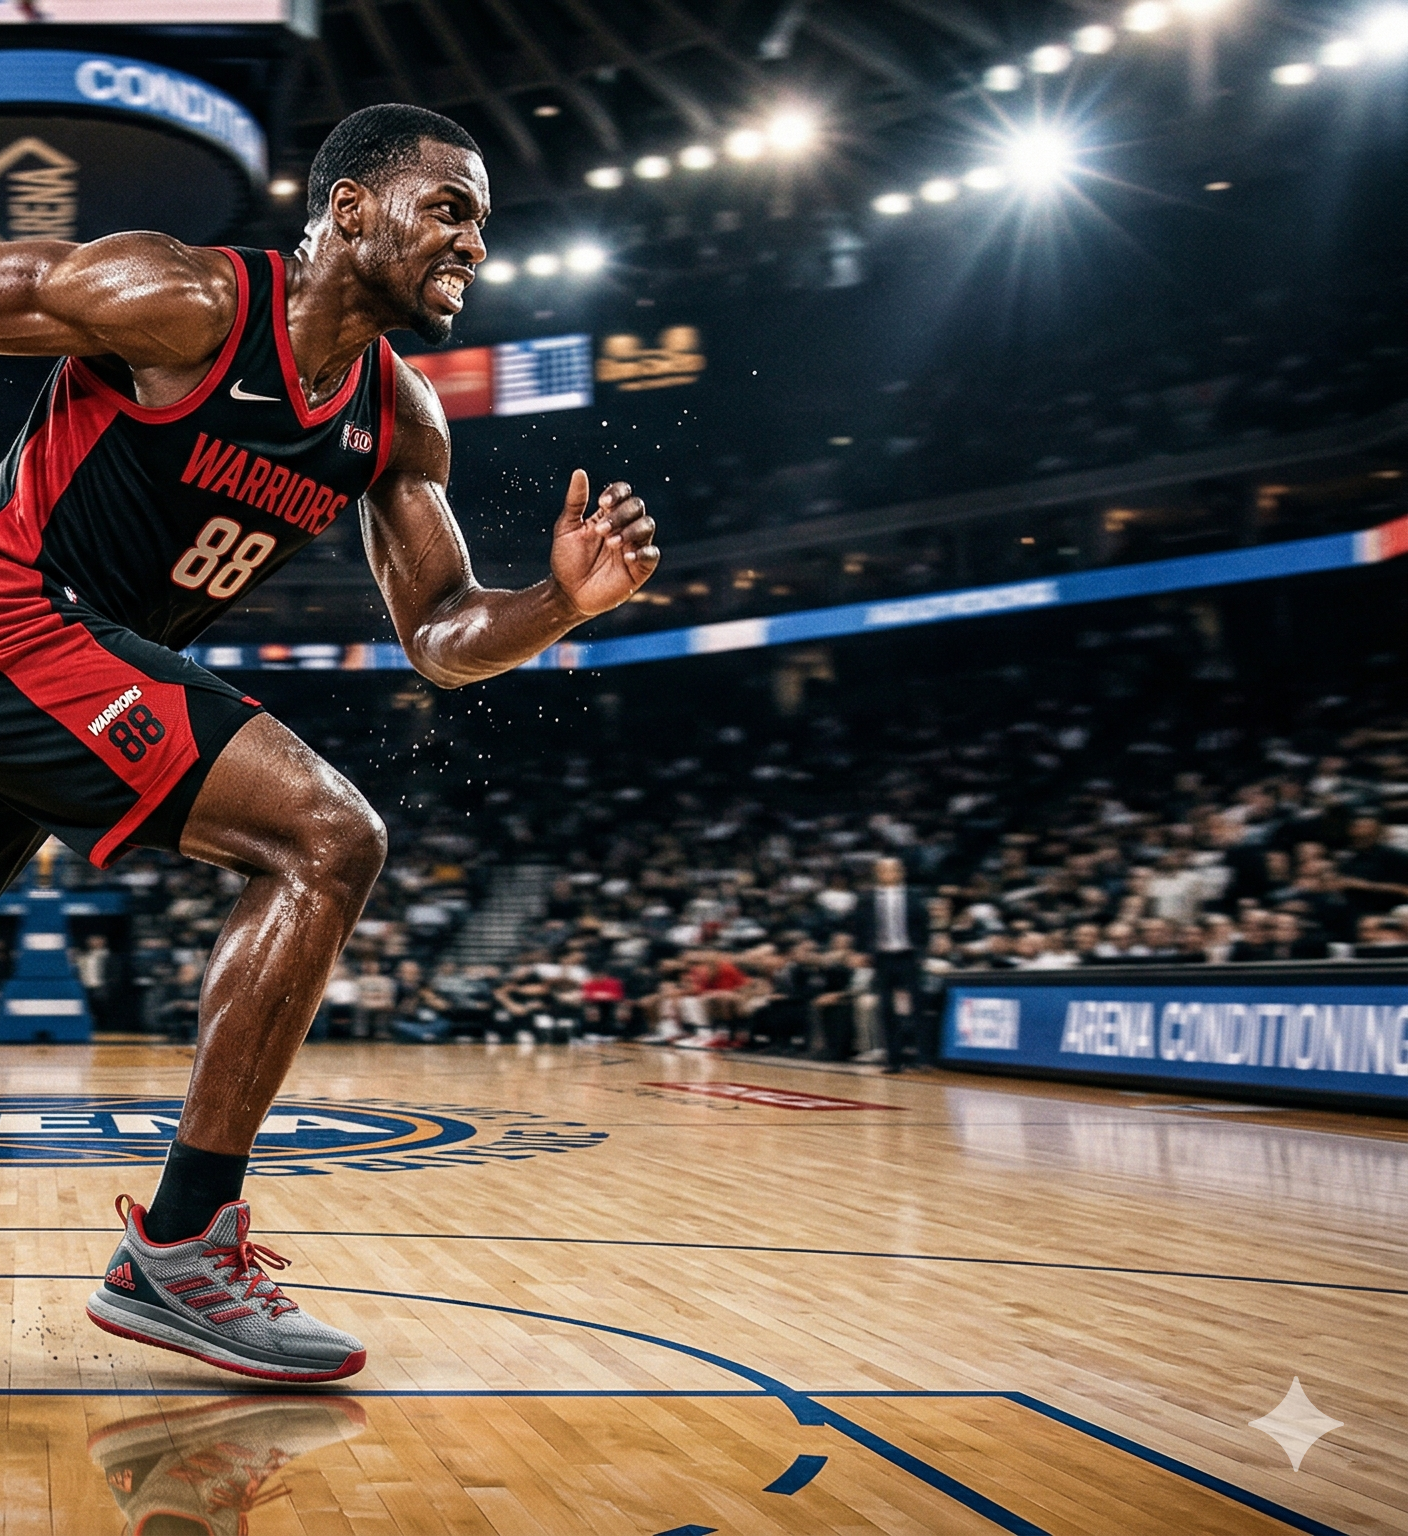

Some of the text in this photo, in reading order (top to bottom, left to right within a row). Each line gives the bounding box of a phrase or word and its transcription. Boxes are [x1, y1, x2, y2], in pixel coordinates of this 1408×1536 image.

[180, 431, 349, 536] WARRIORS
[170, 515, 277, 599] 88
[107, 704, 166, 763] 88
[1060, 1001, 1155, 1059] ARENA
